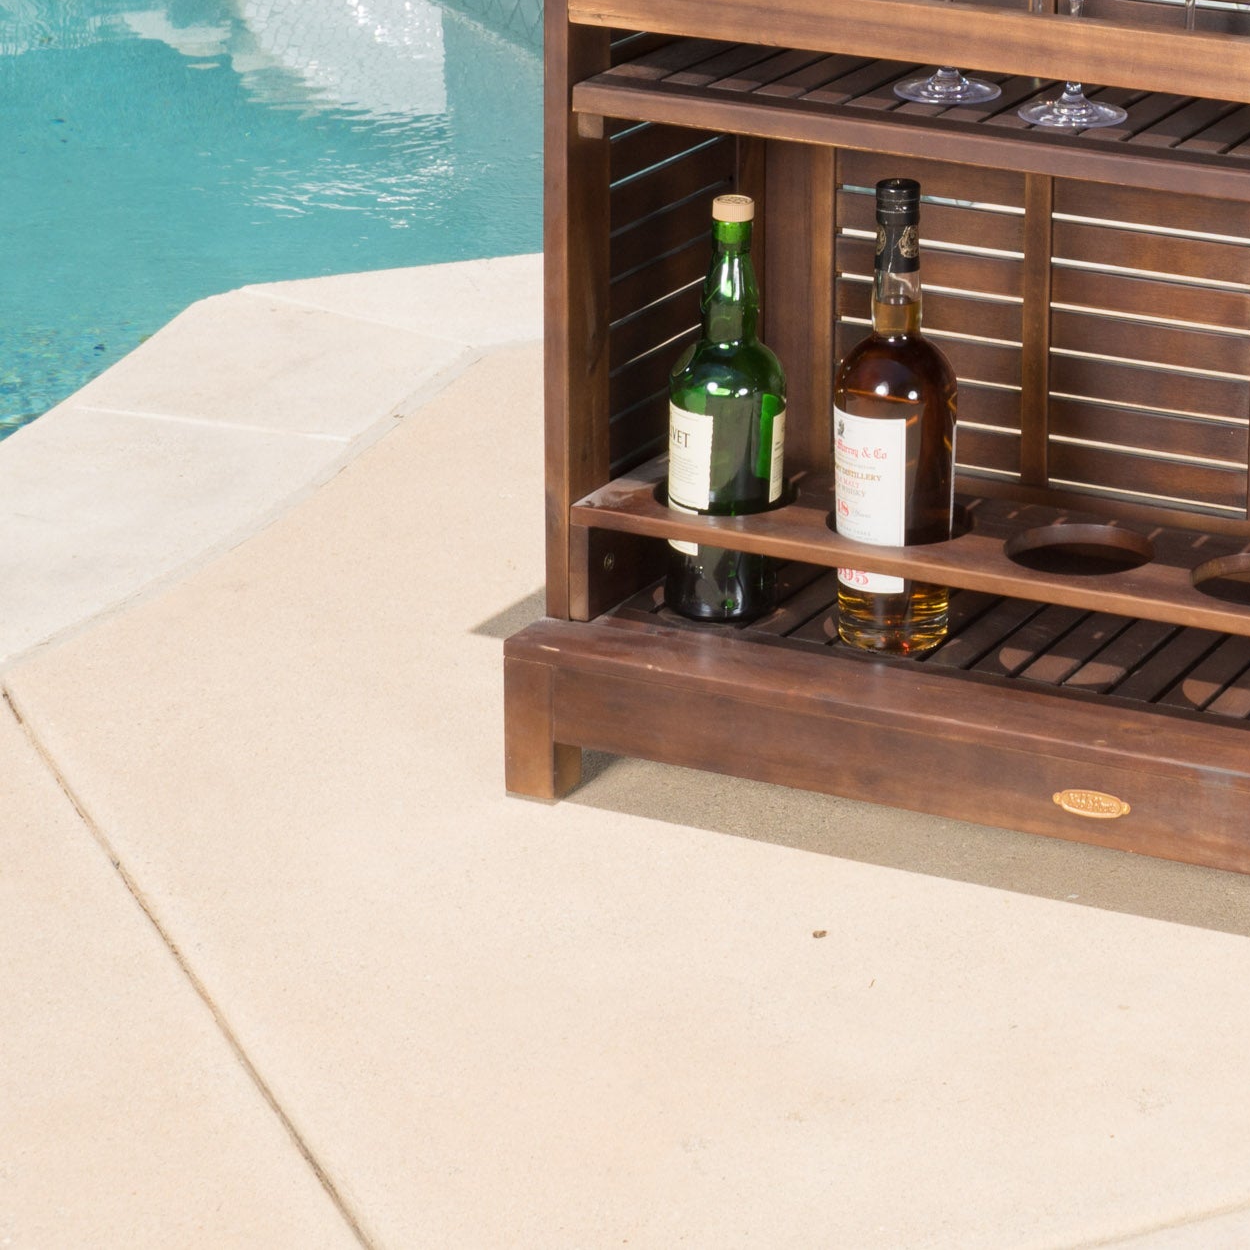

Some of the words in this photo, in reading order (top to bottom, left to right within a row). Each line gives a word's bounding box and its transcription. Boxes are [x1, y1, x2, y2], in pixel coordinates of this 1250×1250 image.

[861, 446, 871, 459] &
[873, 448, 887, 460] Co
[842, 467, 882, 482] DISTILLERY
[837, 498, 850, 516] 18
